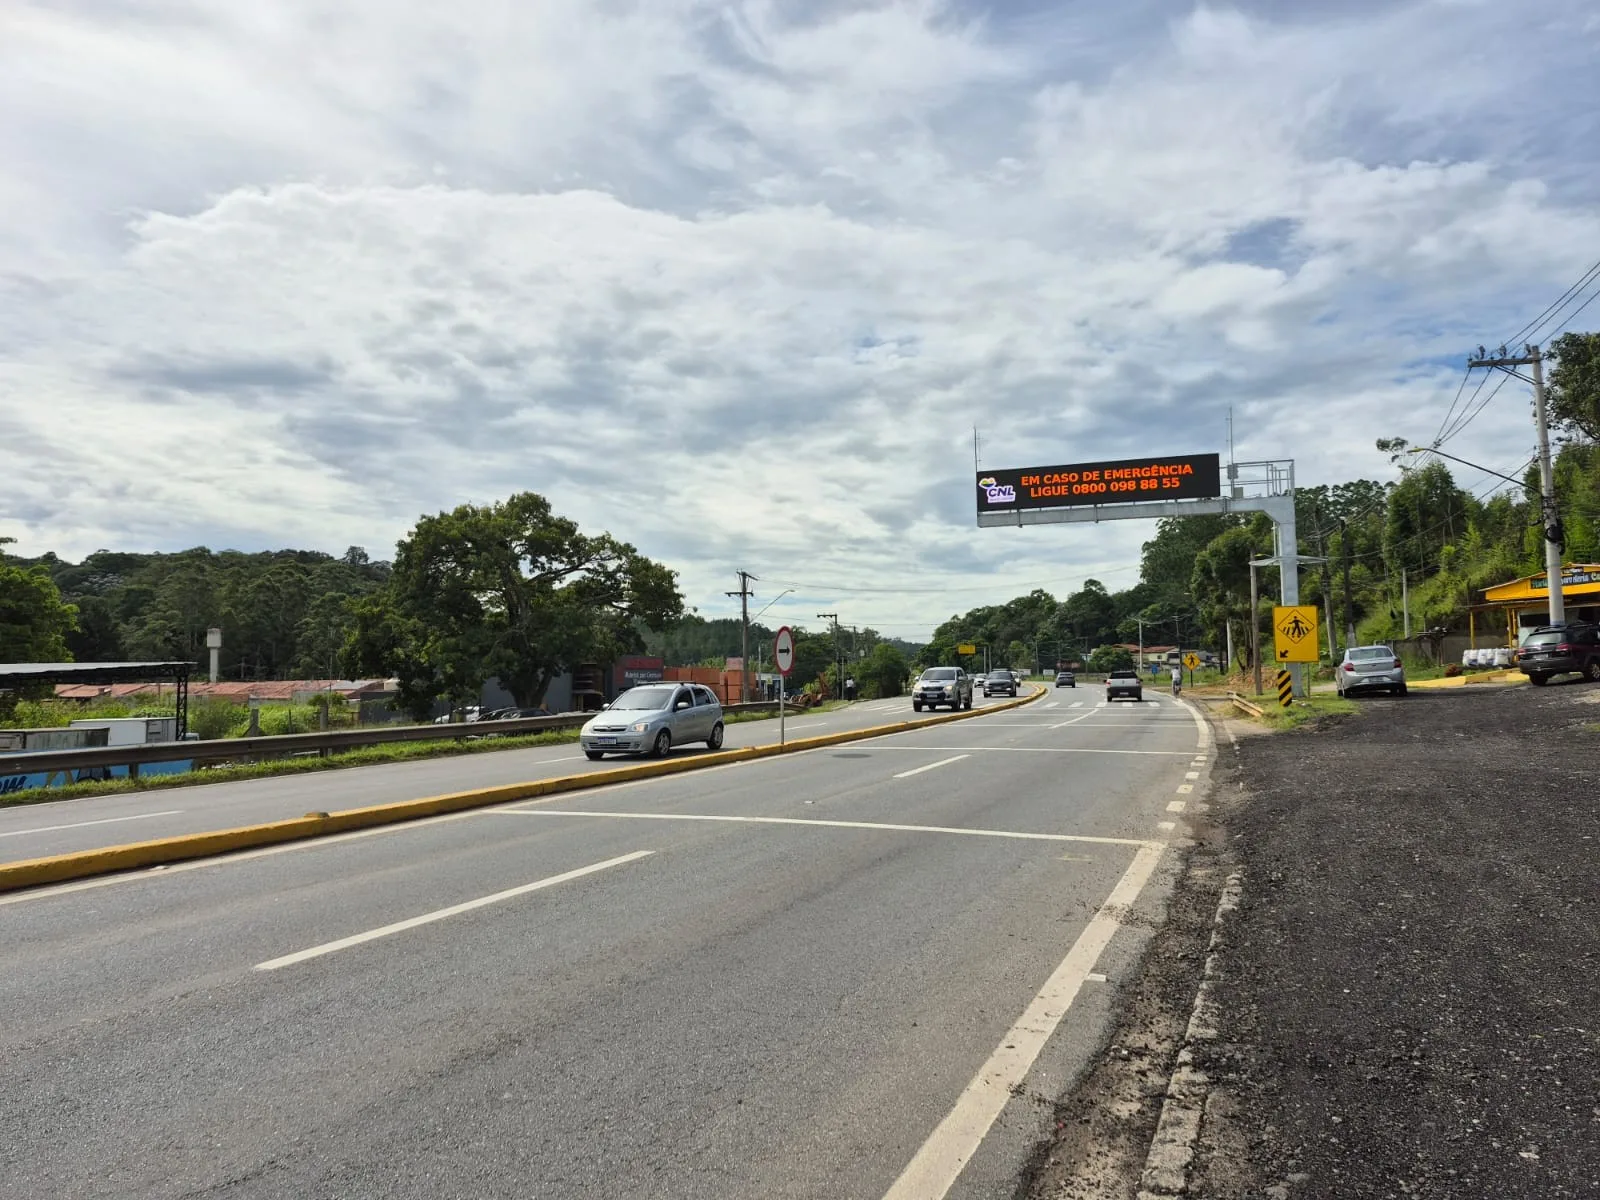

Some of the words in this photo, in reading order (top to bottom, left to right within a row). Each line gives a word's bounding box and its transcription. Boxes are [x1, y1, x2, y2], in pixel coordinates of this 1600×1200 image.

[1021, 475, 1040, 486] EM
[1043, 473, 1079, 485] CASO
[1082, 470, 1100, 482] DE
[1104, 464, 1193, 480] EMERGÊNCIA
[988, 486, 1014, 498] CNL
[1030, 485, 1069, 498] LIGUE
[1072, 483, 1107, 495] 0800
[1109, 480, 1137, 492] 098
[1140, 479, 1158, 490] 88
[1162, 478, 1180, 489] 55
